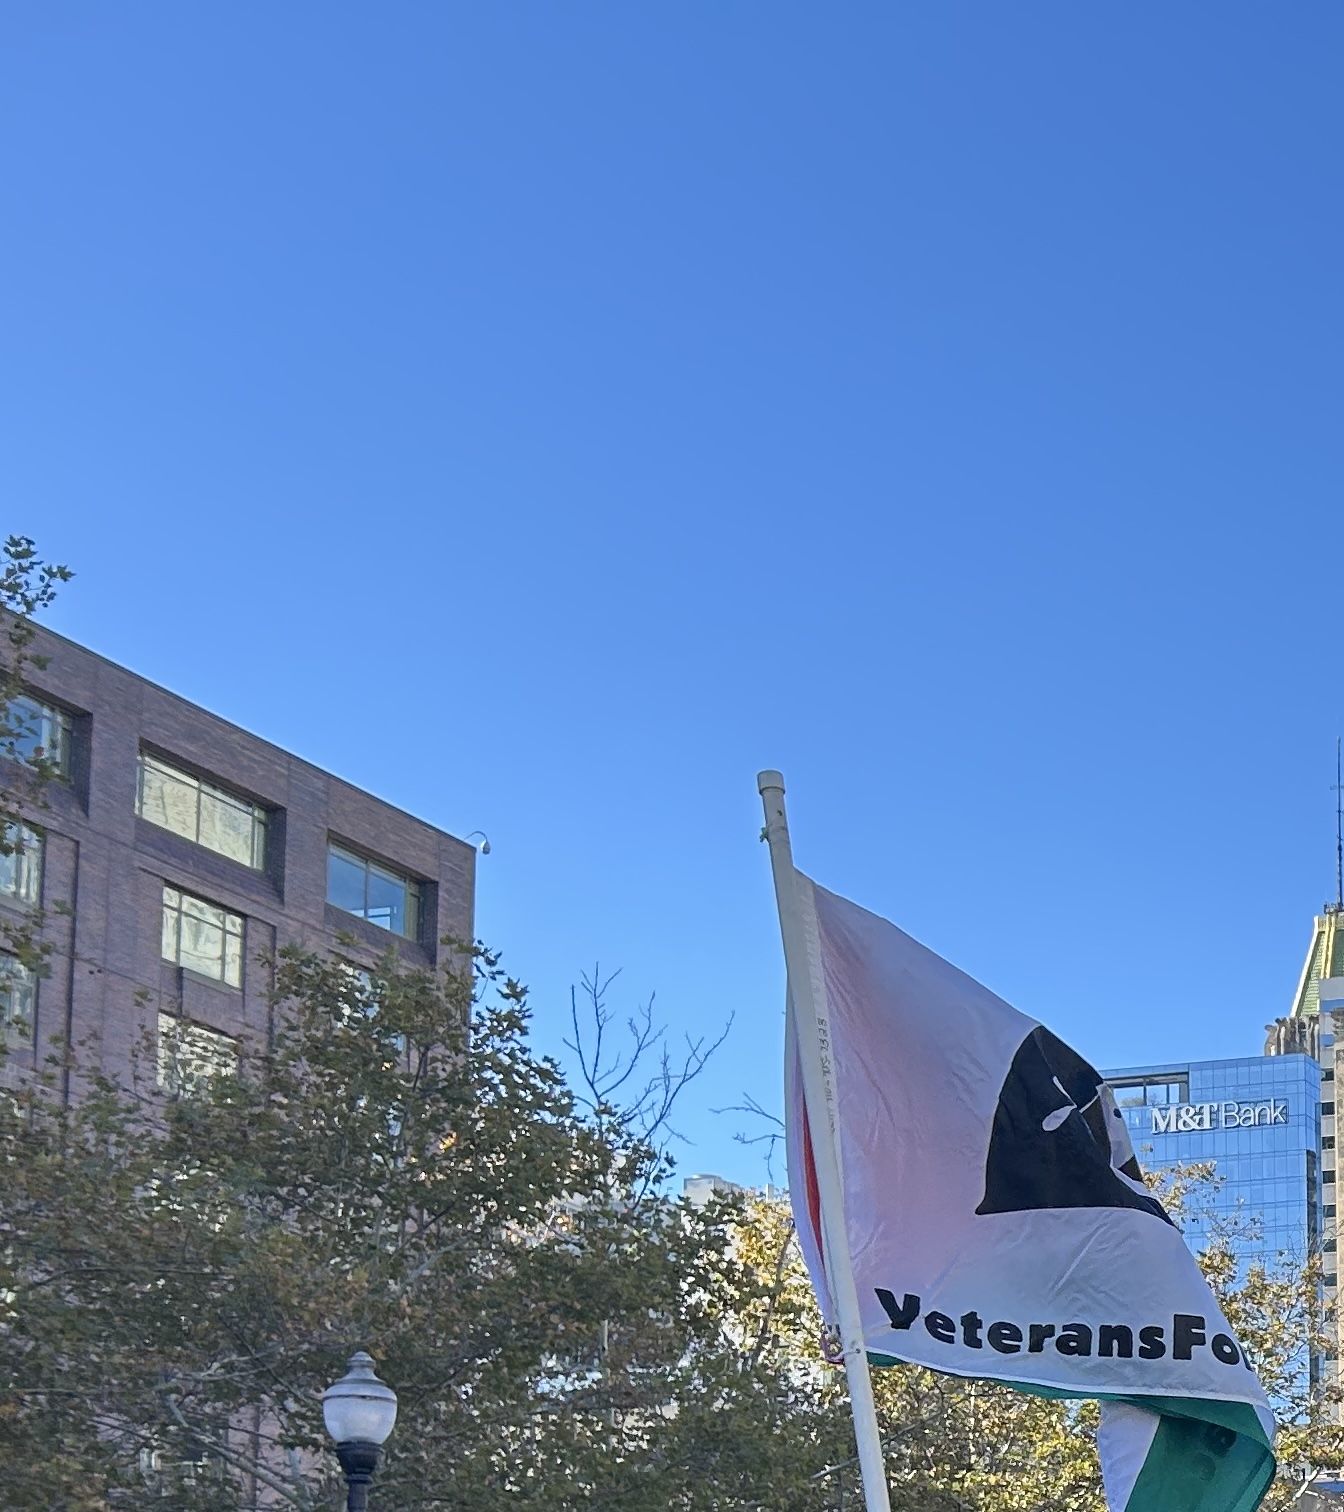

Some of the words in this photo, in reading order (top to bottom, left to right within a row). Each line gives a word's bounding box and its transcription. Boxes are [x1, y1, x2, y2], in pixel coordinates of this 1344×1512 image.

[1150, 1102, 1217, 1134] M&T
[1222, 1097, 1287, 1129] Bank
[873, 1287, 1252, 1372] VeteransFo
